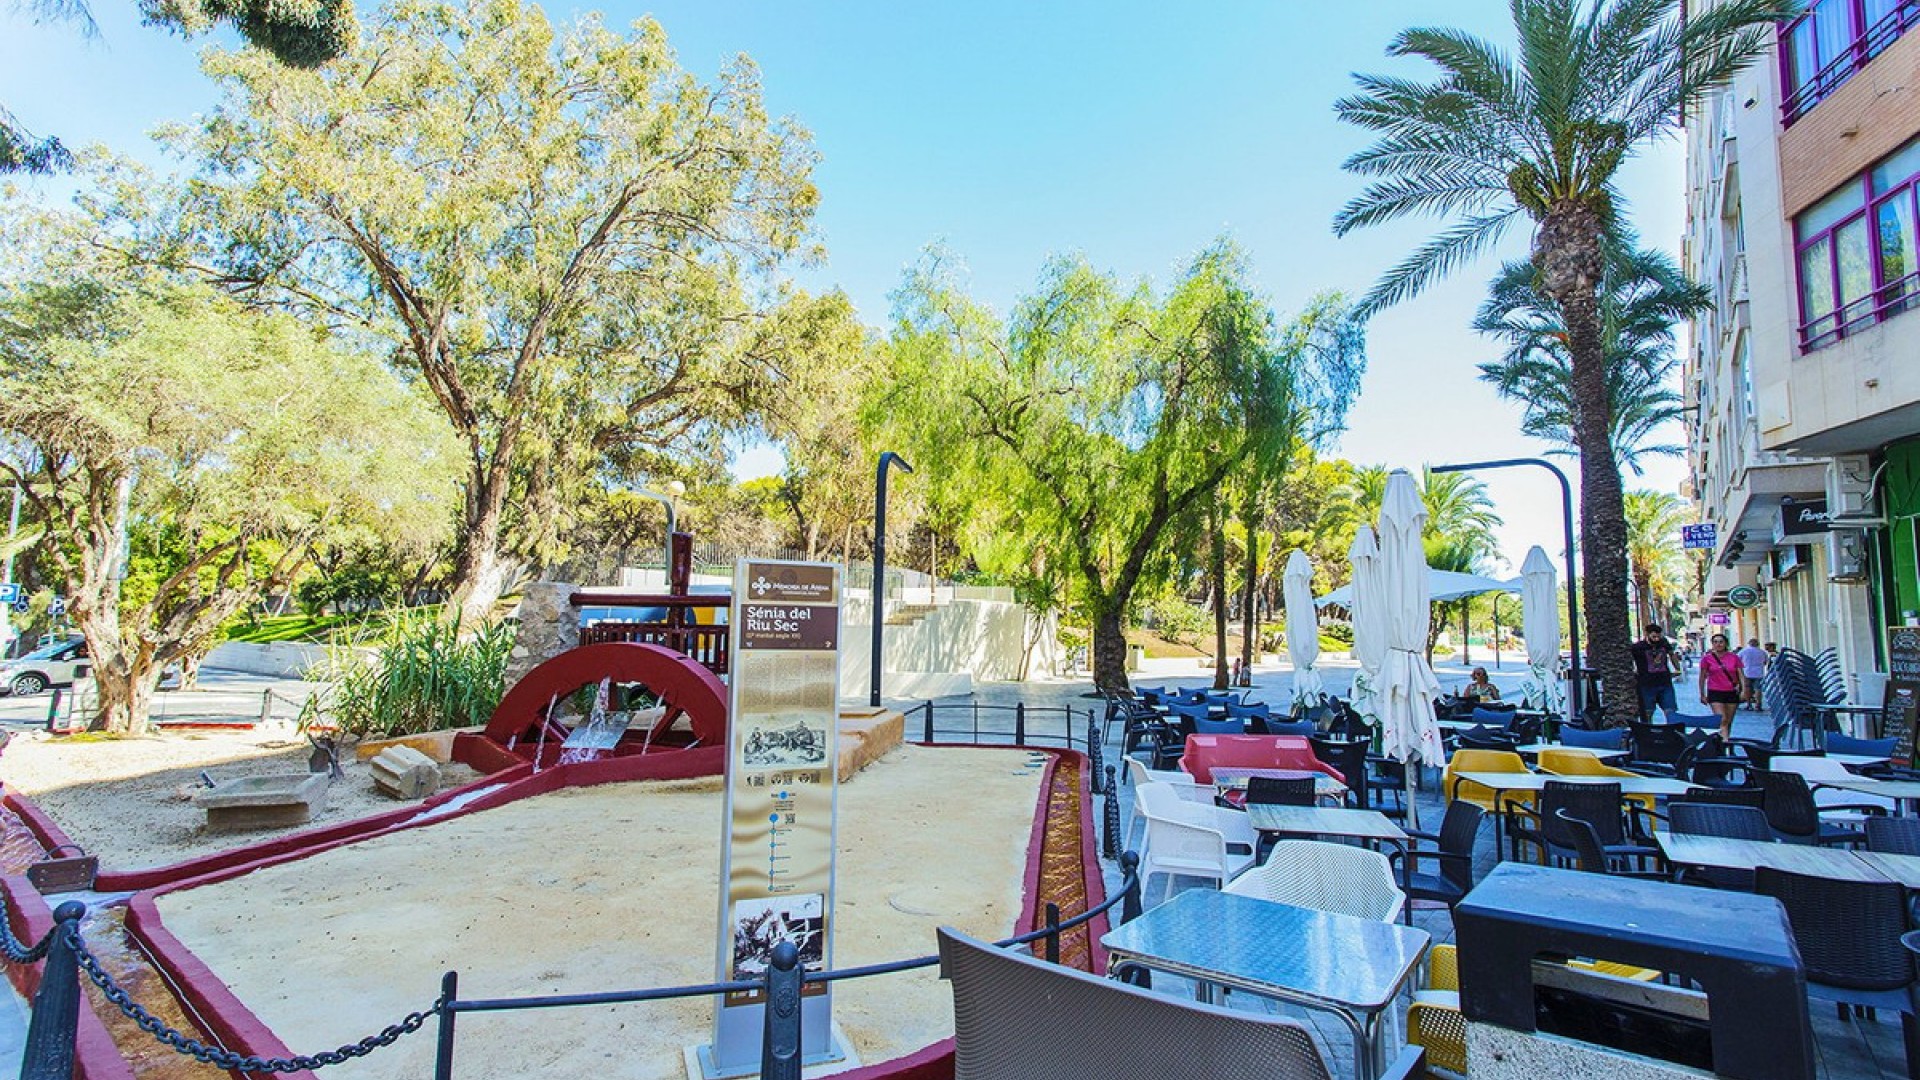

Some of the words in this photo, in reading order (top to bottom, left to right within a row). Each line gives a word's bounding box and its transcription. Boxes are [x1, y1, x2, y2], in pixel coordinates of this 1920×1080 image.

[747, 606, 786, 619] Sénia
[789, 608, 811, 620] del
[747, 619, 771, 631] Riu
[774, 620, 799, 631] Sec
